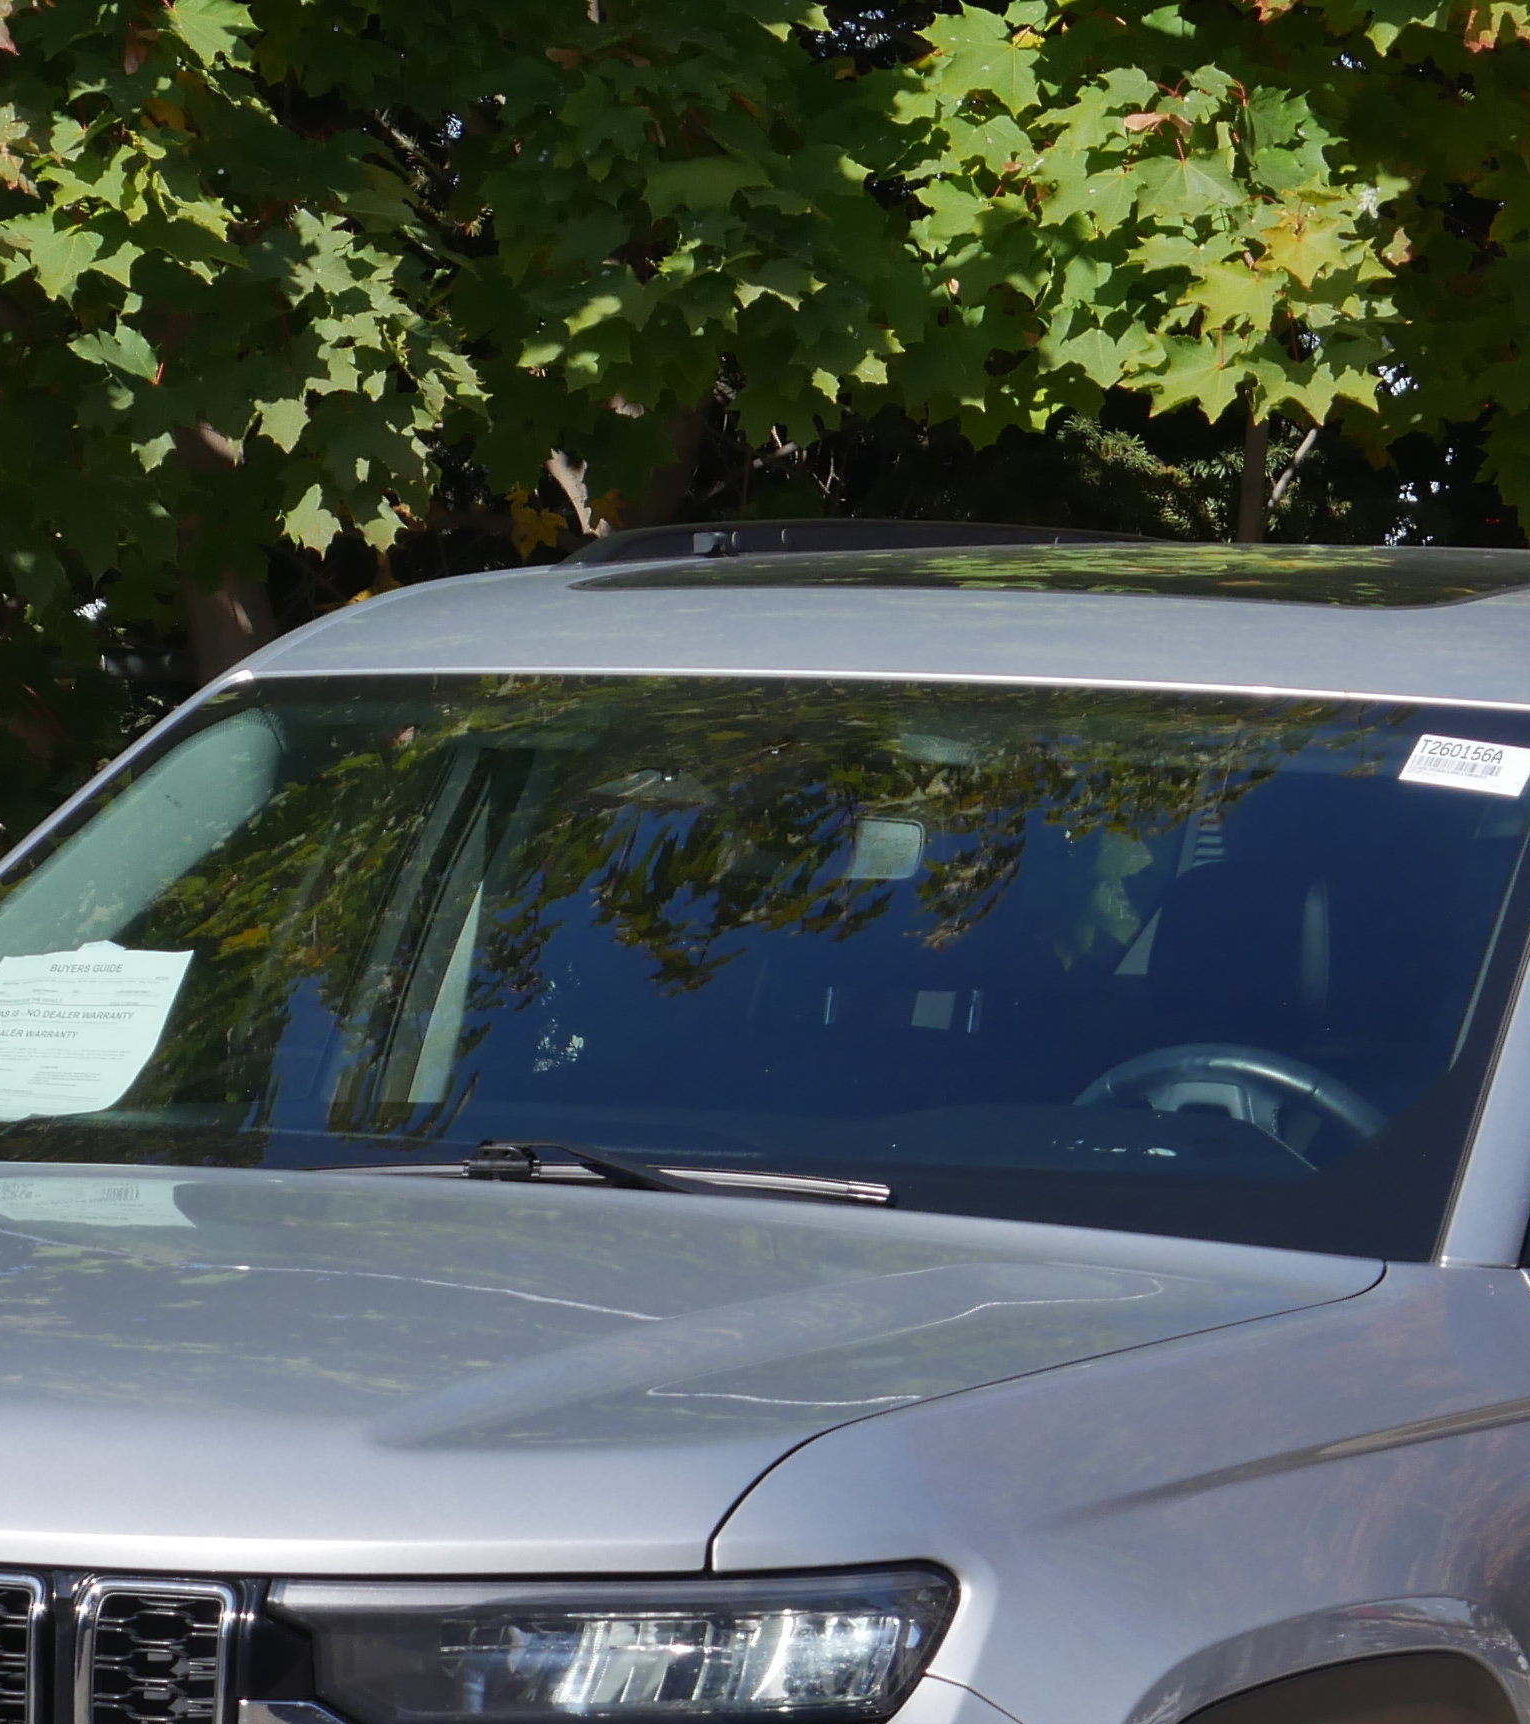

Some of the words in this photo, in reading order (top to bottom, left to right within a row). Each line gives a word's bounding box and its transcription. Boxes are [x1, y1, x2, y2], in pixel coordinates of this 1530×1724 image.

[1420, 739, 1504, 765] T260156A
[49, 963, 91, 974] BUYERS
[92, 963, 124, 973] GUIDE
[25, 1009, 41, 1018] NO
[42, 1010, 80, 1020] DEALER
[81, 1011, 135, 1020] WARRANTY
[25, 1030, 80, 1039] WARRANTY
